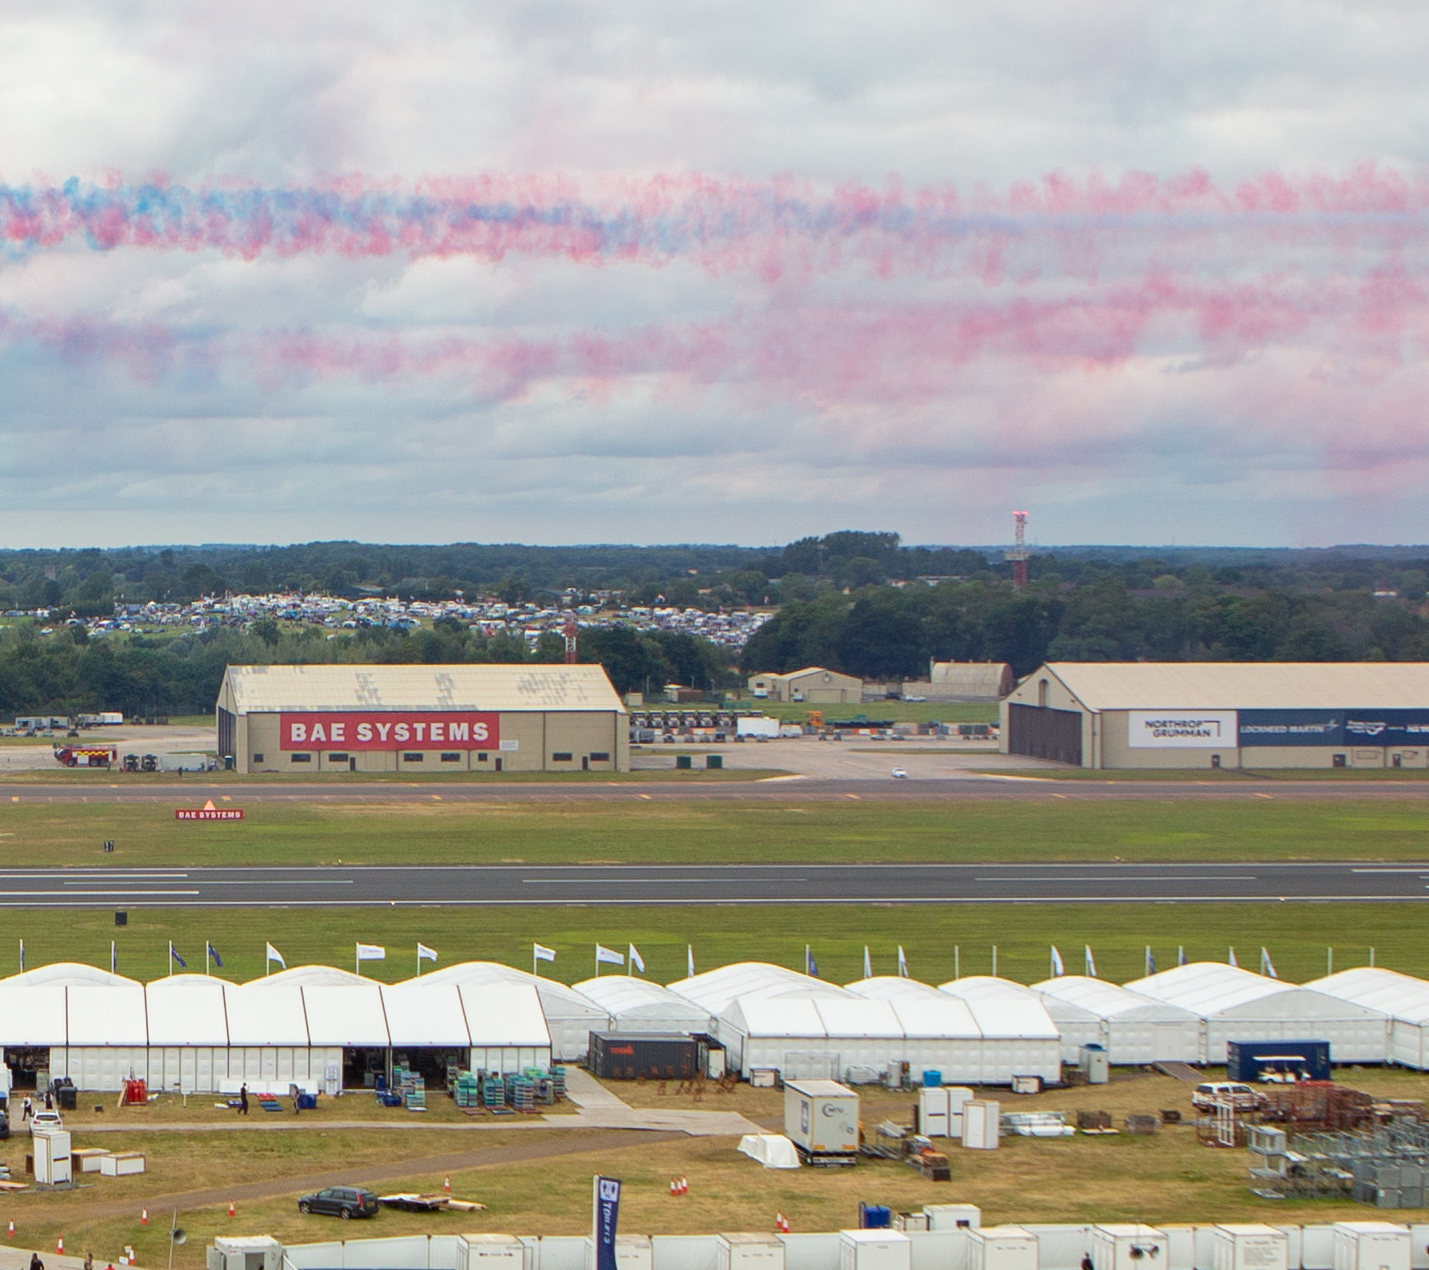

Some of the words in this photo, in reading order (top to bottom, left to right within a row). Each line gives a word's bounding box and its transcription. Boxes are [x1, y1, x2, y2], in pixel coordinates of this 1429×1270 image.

[1144, 719, 1204, 729] NORTHROP
[290, 722, 346, 742] BAE
[355, 722, 490, 742] SYSTEMS
[1152, 729, 1211, 738] GRUMMAN
[178, 811, 197, 819] BAE
[199, 811, 241, 819] SYSTEMS
